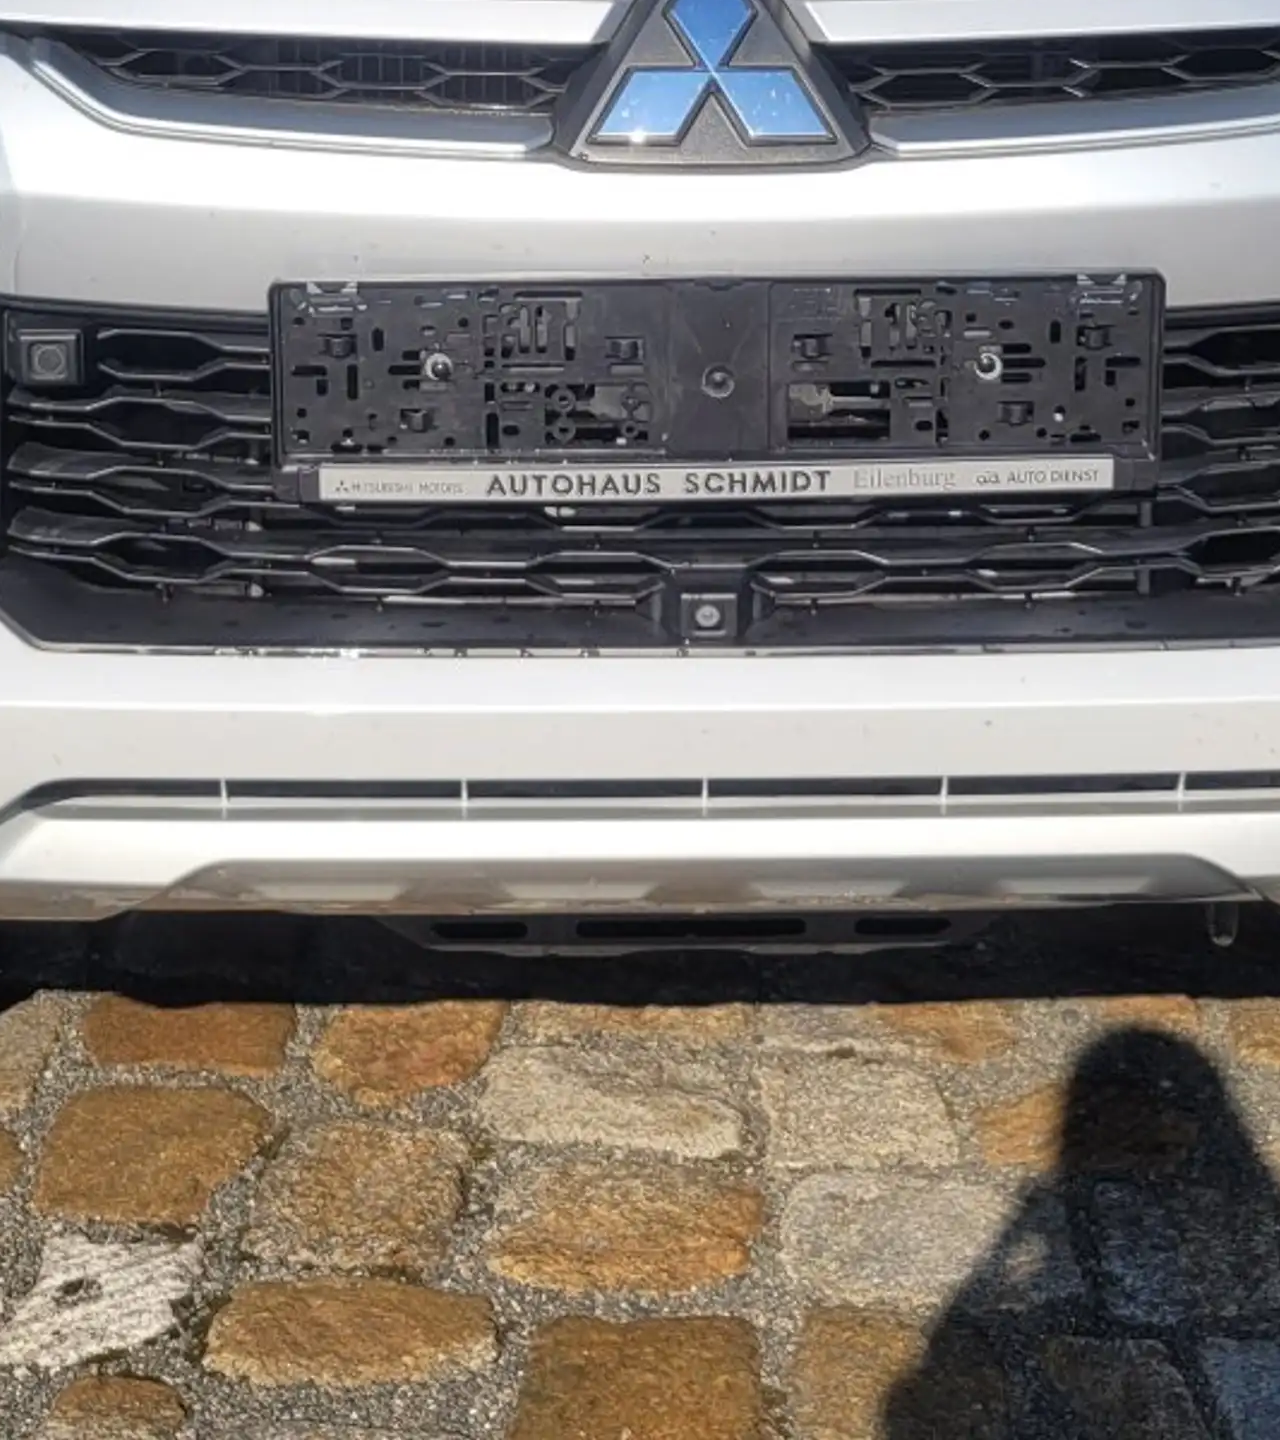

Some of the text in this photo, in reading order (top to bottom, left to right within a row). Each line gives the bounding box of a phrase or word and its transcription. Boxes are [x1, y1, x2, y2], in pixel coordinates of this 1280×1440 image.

[486, 472, 661, 497] AUTOHAUS
[685, 470, 831, 495] SCHMIDT
[853, 467, 957, 490] Eilenburg
[1006, 469, 1046, 484] AUTO
[1050, 467, 1099, 483] DIENST
